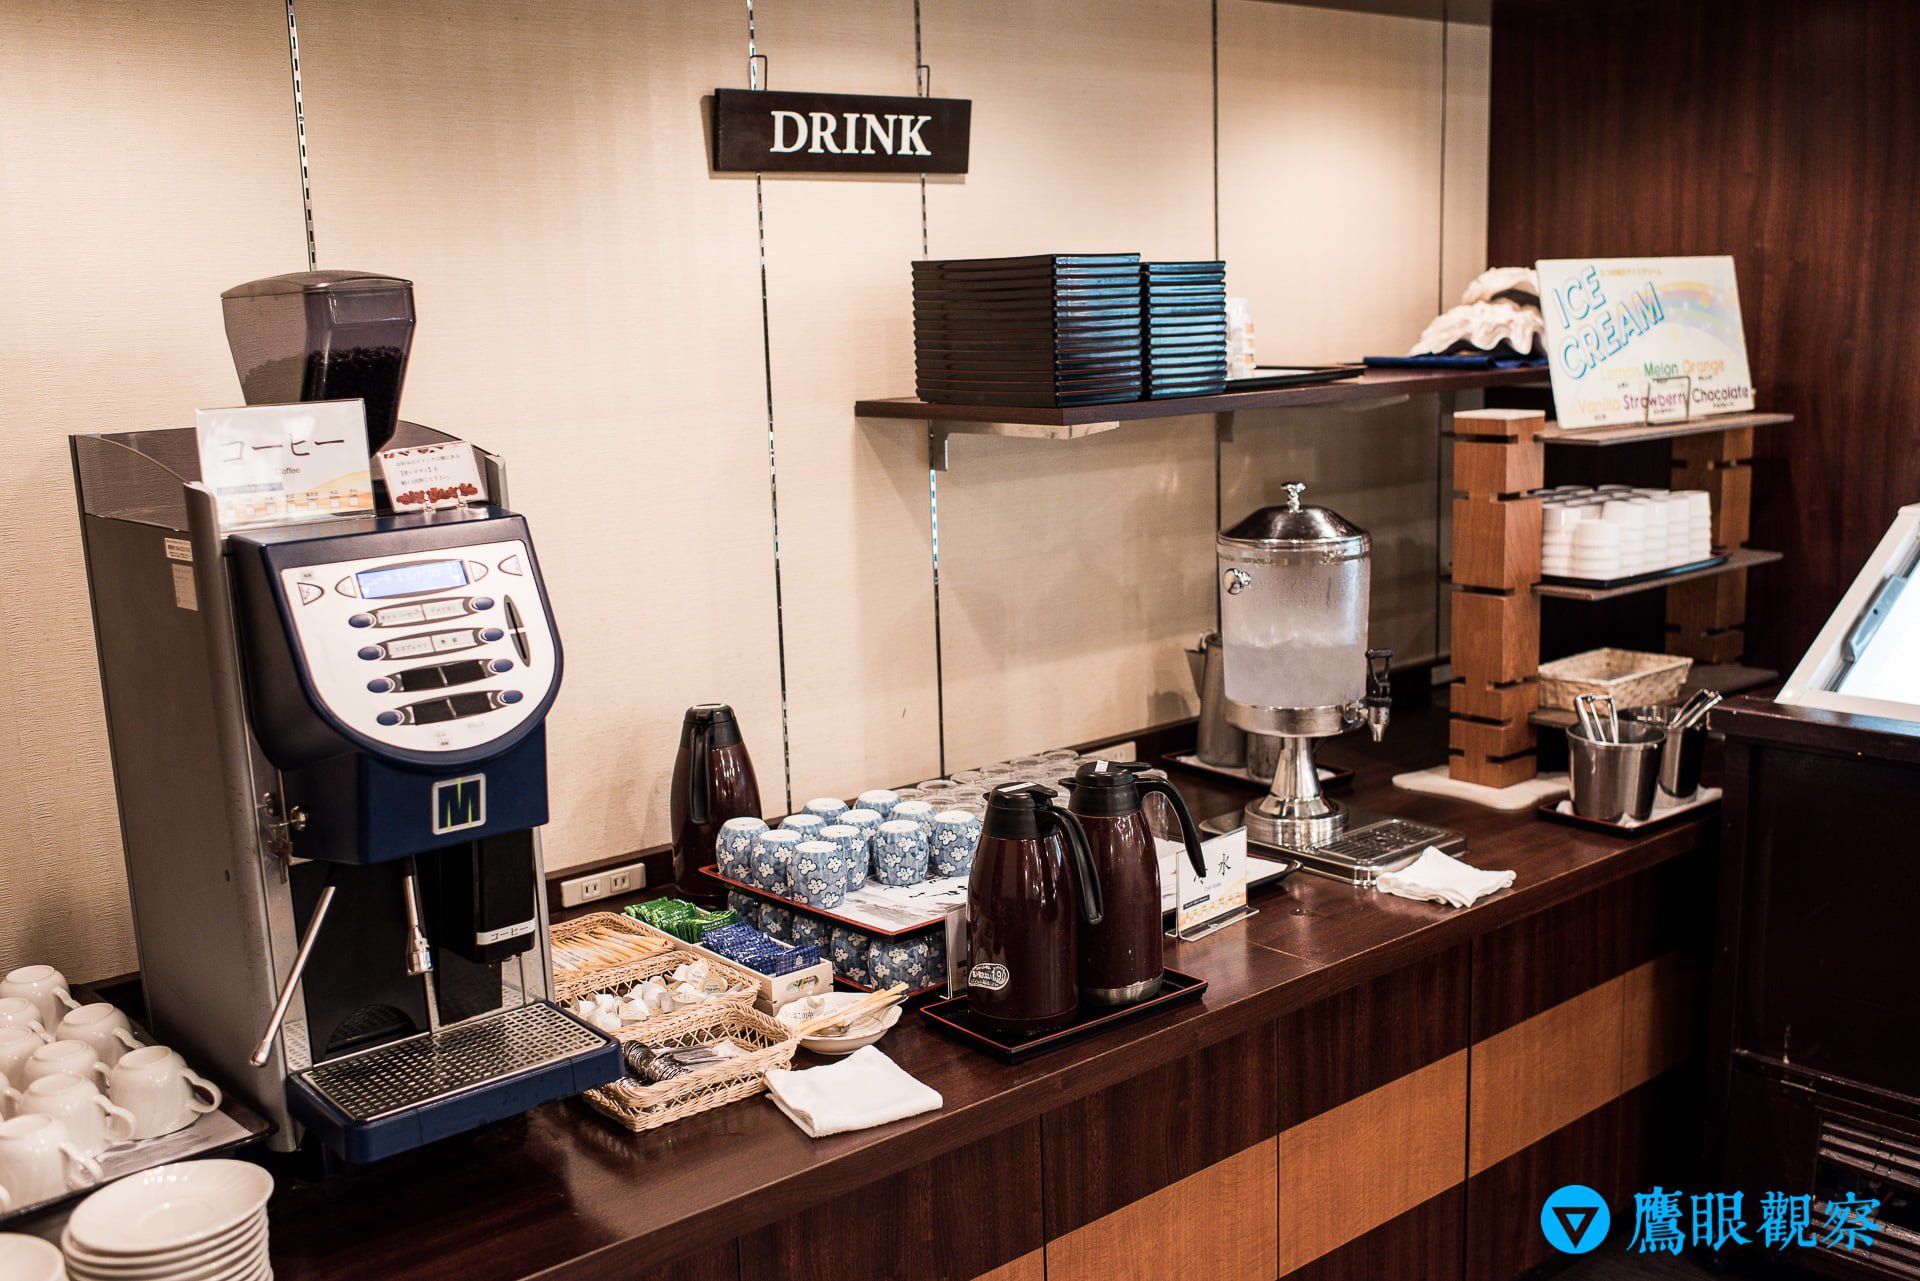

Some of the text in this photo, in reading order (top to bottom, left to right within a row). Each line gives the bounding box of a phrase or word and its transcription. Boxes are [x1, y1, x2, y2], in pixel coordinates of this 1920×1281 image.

[769, 110, 932, 156] DRINK
[1552, 265, 1607, 329] ICE
[1558, 281, 1665, 379] CREAM
[1643, 362, 1679, 378] Melon
[1681, 359, 1725, 376] Orange
[1623, 391, 1689, 411] Strawberry
[1692, 384, 1749, 404] Chocolate
[220, 432, 345, 464] コーヒー
[275, 465, 301, 475] Coffee
[490, 926, 529, 941] コーヒー
